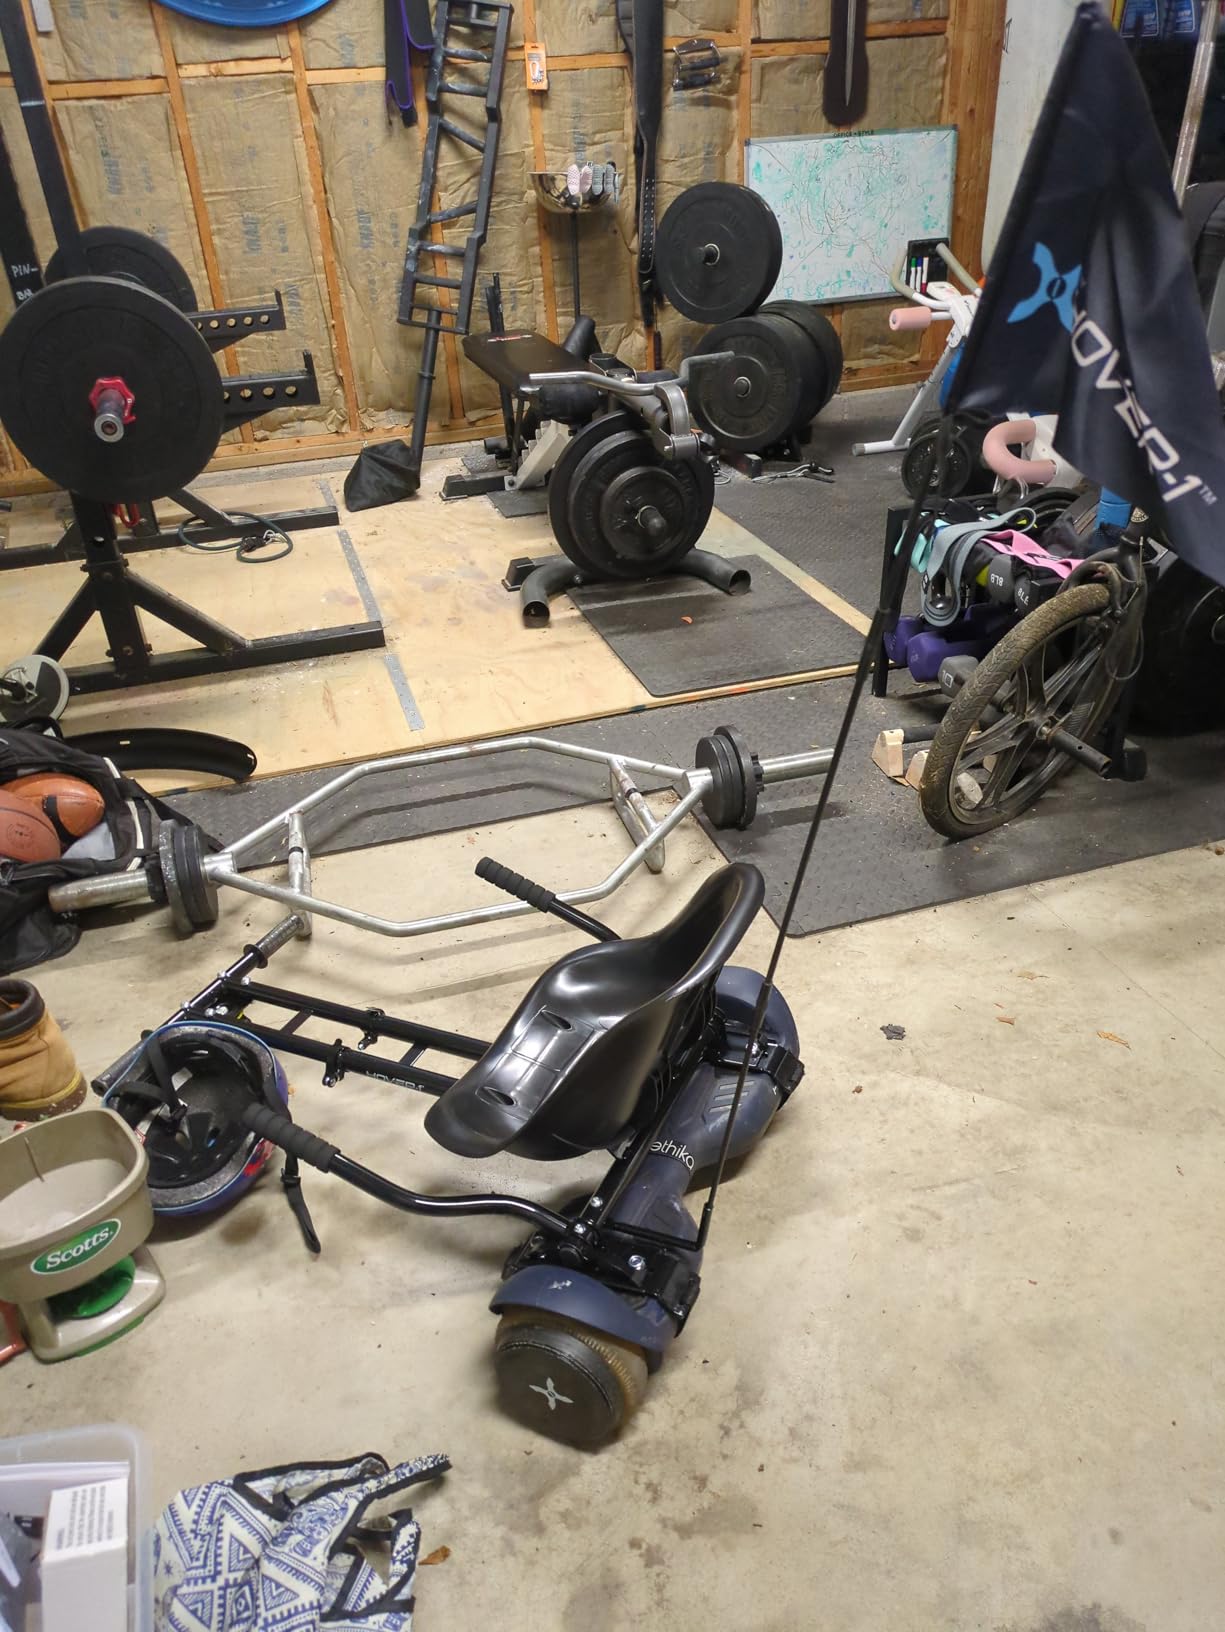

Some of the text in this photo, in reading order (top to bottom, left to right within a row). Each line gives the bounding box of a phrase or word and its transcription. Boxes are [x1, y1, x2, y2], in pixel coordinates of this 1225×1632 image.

[990, 573, 1004, 587] 8LB
[943, 669, 954, 689] 10
[650, 1139, 695, 1170] ethika
[46, 1226, 110, 1270] Scotts
